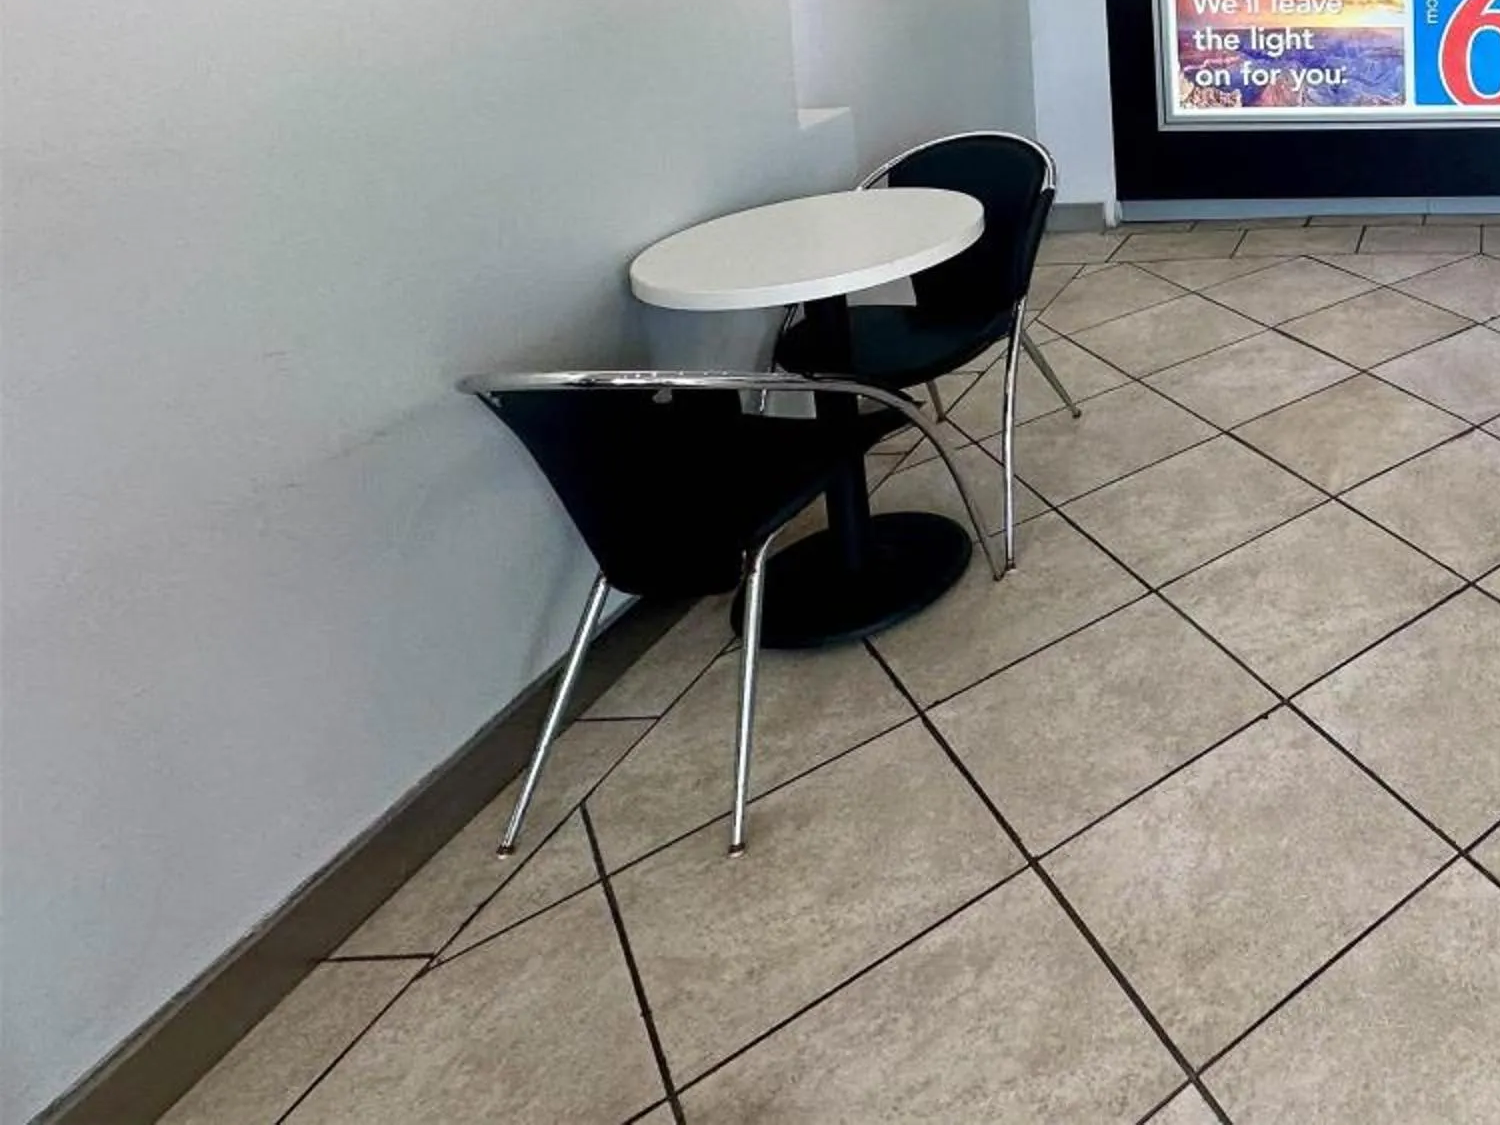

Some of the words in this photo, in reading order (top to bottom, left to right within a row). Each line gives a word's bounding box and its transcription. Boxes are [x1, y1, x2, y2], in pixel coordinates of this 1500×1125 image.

[1192, 26, 1241, 52] the
[1250, 25, 1315, 58] light
[1195, 68, 1231, 87] on
[1241, 61, 1281, 86] for
